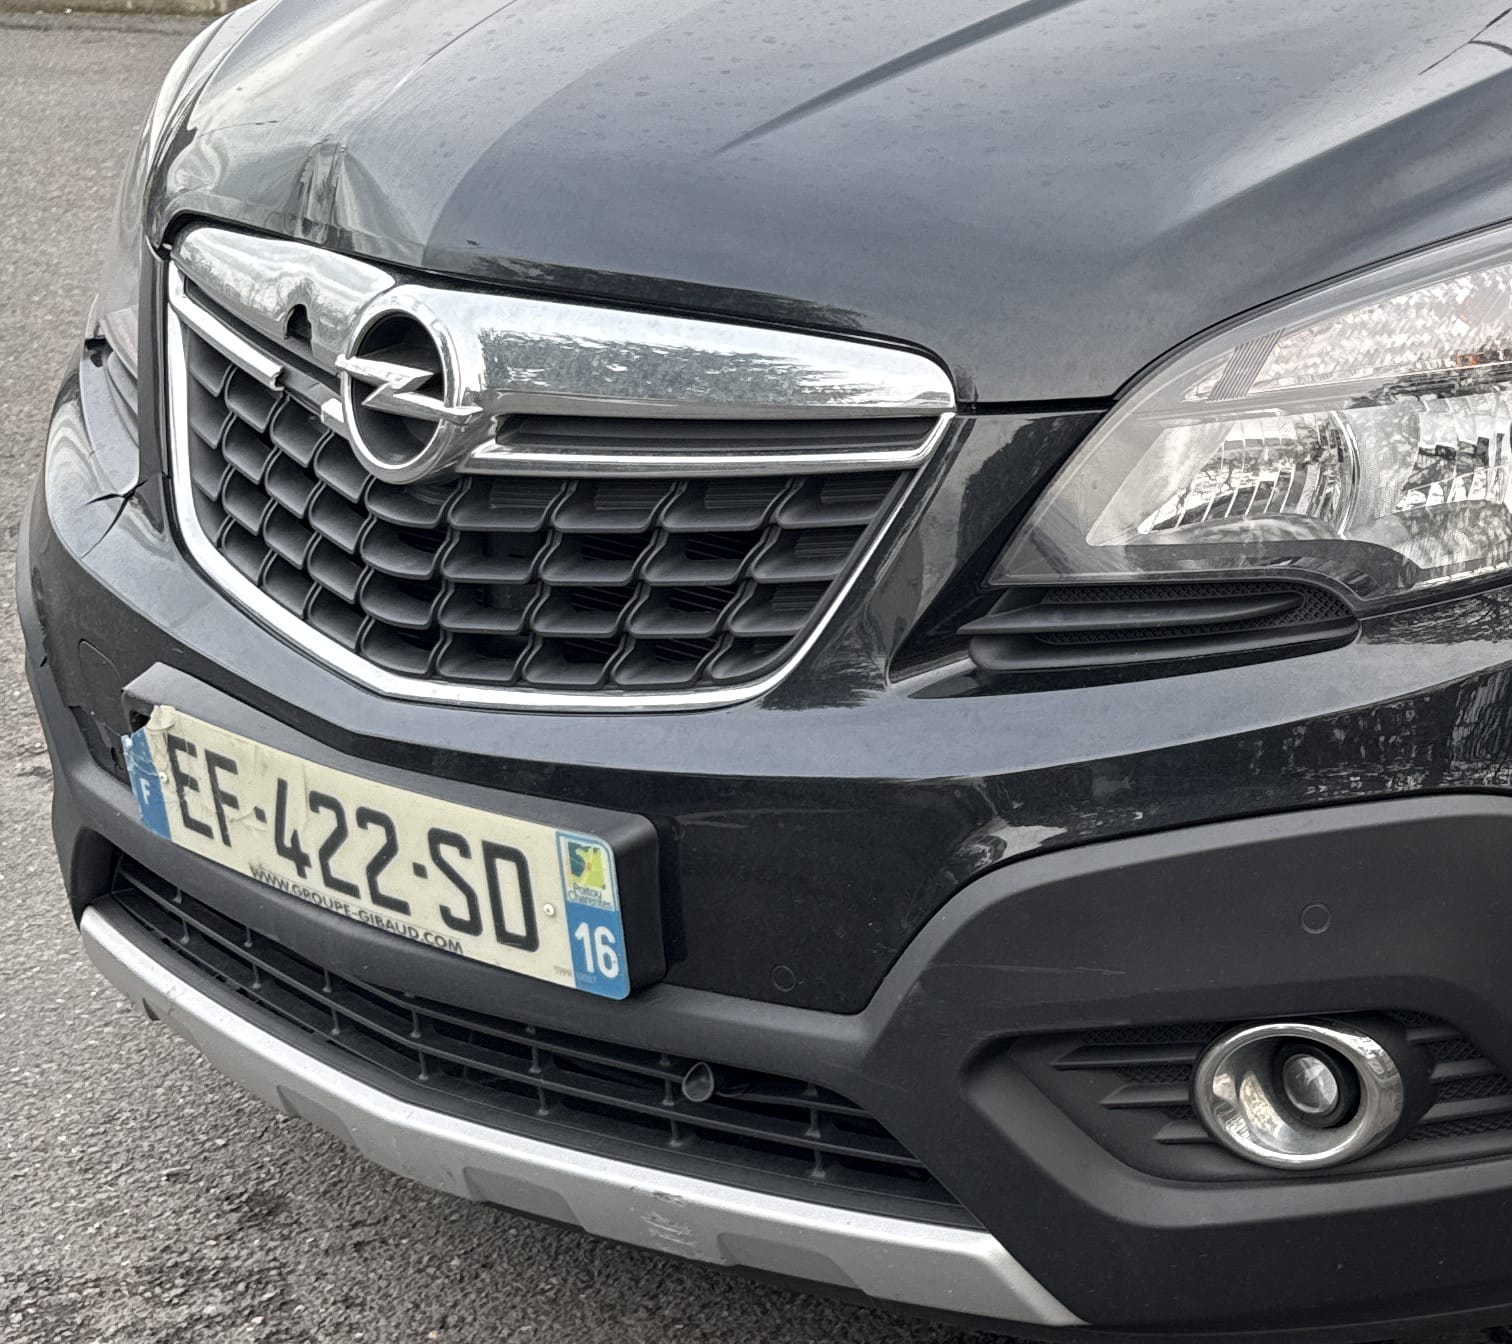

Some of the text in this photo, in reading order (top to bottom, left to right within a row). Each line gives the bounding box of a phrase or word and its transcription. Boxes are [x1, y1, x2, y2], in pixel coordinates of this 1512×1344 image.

[139, 777, 151, 806] F
[166, 733, 540, 953] EF-422-SD
[249, 863, 464, 955] WWW.GROUPE-GIBAUD.COM
[574, 921, 620, 979] 16
